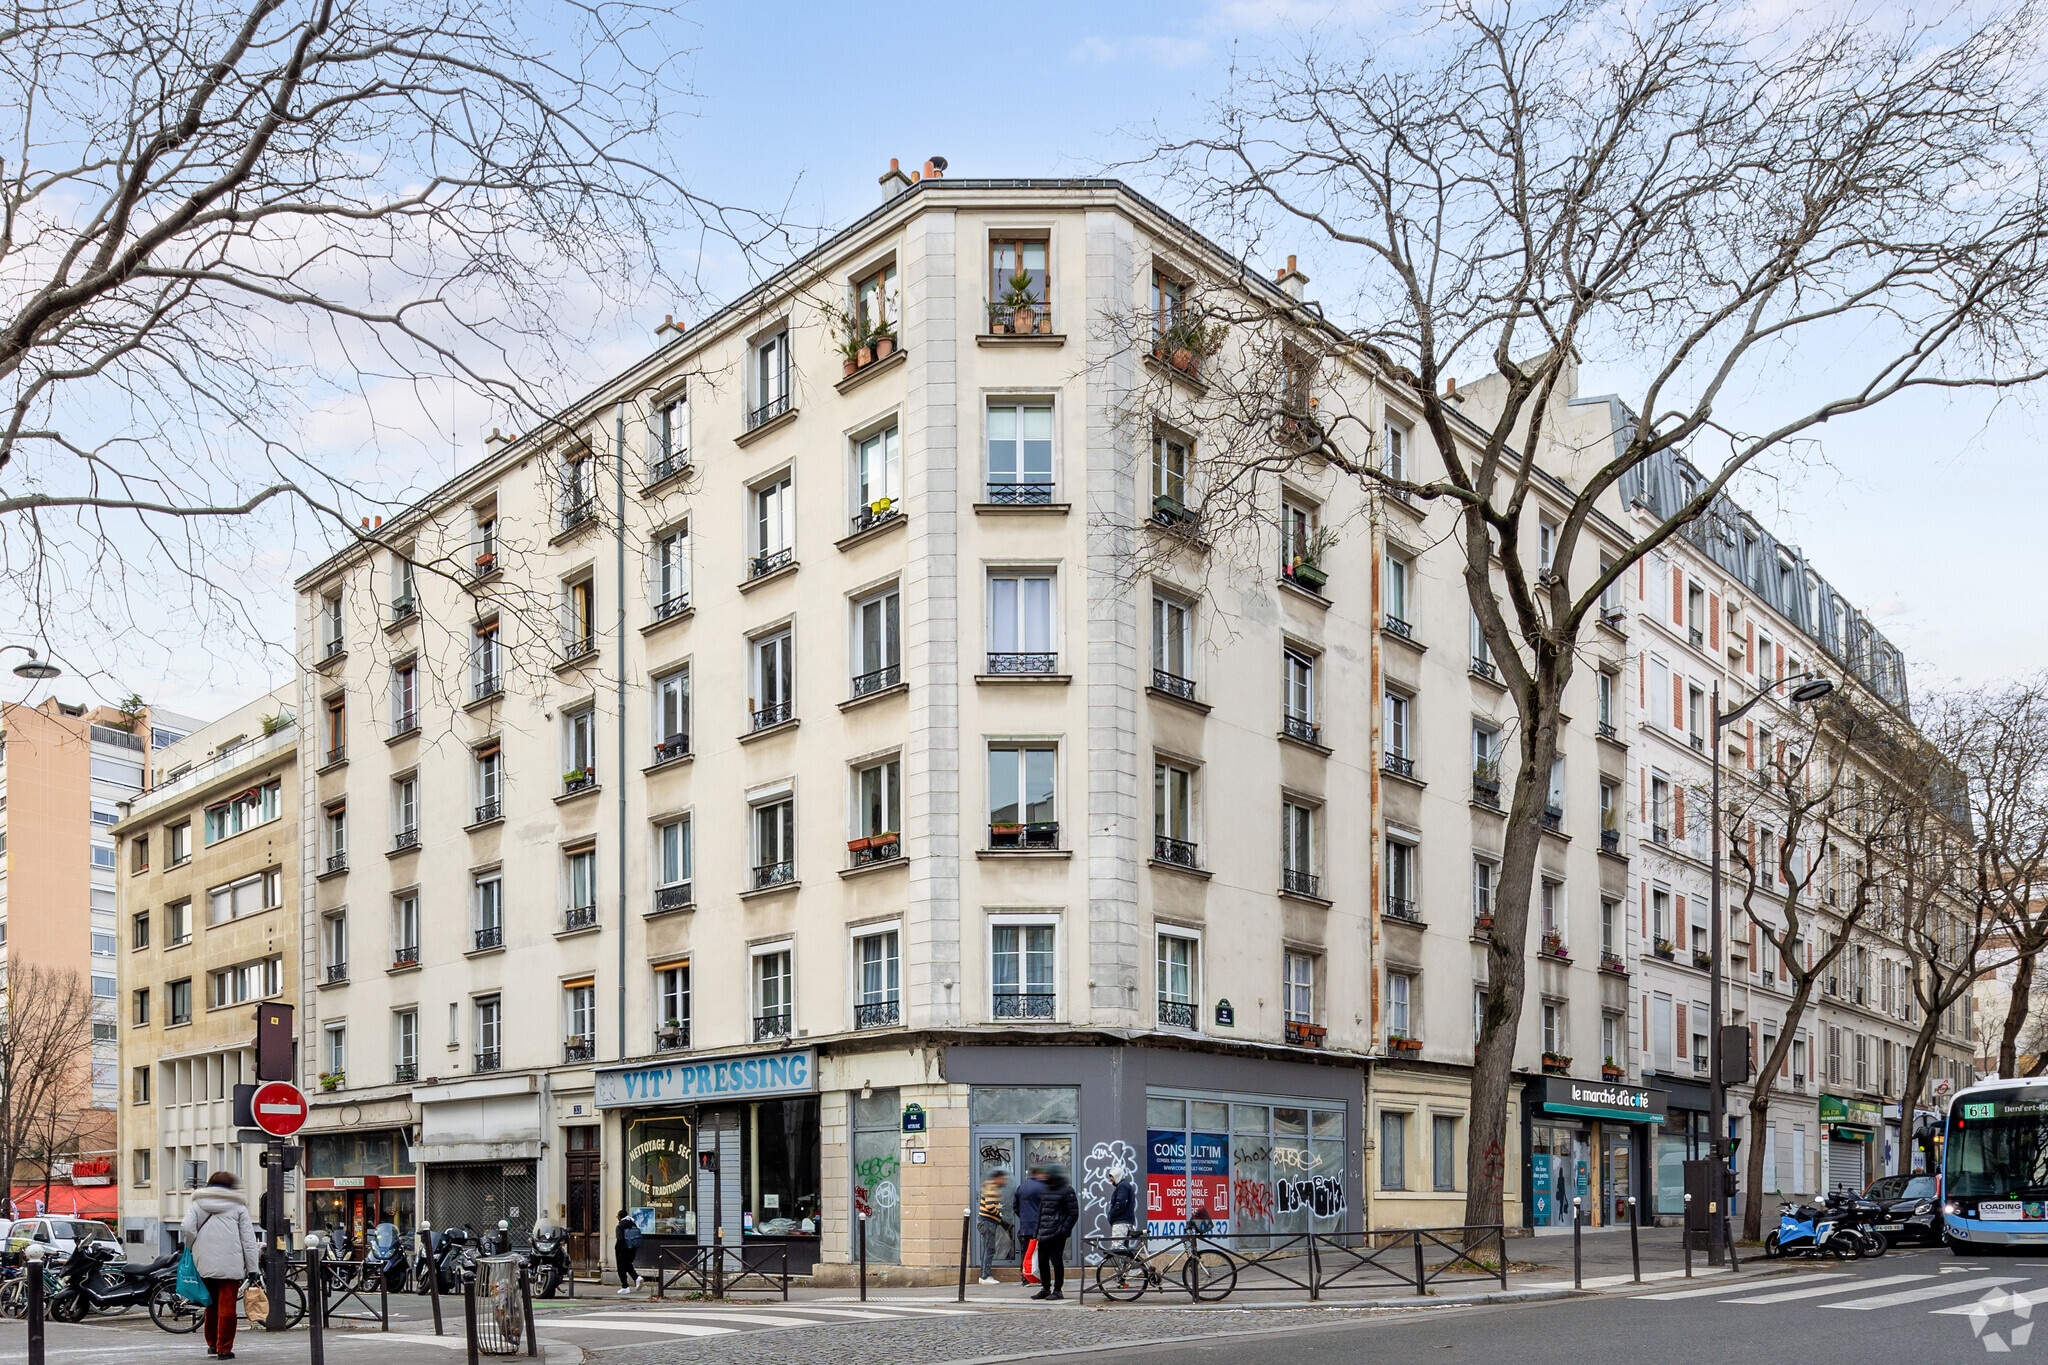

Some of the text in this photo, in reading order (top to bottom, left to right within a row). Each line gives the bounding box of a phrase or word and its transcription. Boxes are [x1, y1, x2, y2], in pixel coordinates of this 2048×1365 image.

[623, 1055, 808, 1100] VIT' PRESSING
[1572, 1084, 1582, 1101] le
[1582, 1087, 1616, 1104] marché
[1630, 1092, 1648, 1108] côté
[1970, 1106, 1988, 1117] 64
[629, 1138, 691, 1162] NETTOYAGE A SEC
[1154, 1143, 1221, 1158] CONSULT'IM
[336, 1178, 362, 1186] TAPISSIER
[629, 1174, 691, 1196] SERVICE TRADITIONNEL
[1173, 1179, 1203, 1187] LOCAUX
[1172, 1198, 1204, 1206] LOCATION
[1162, 1222, 1175, 1241] 48
[1216, 1221, 1228, 1240] 32
